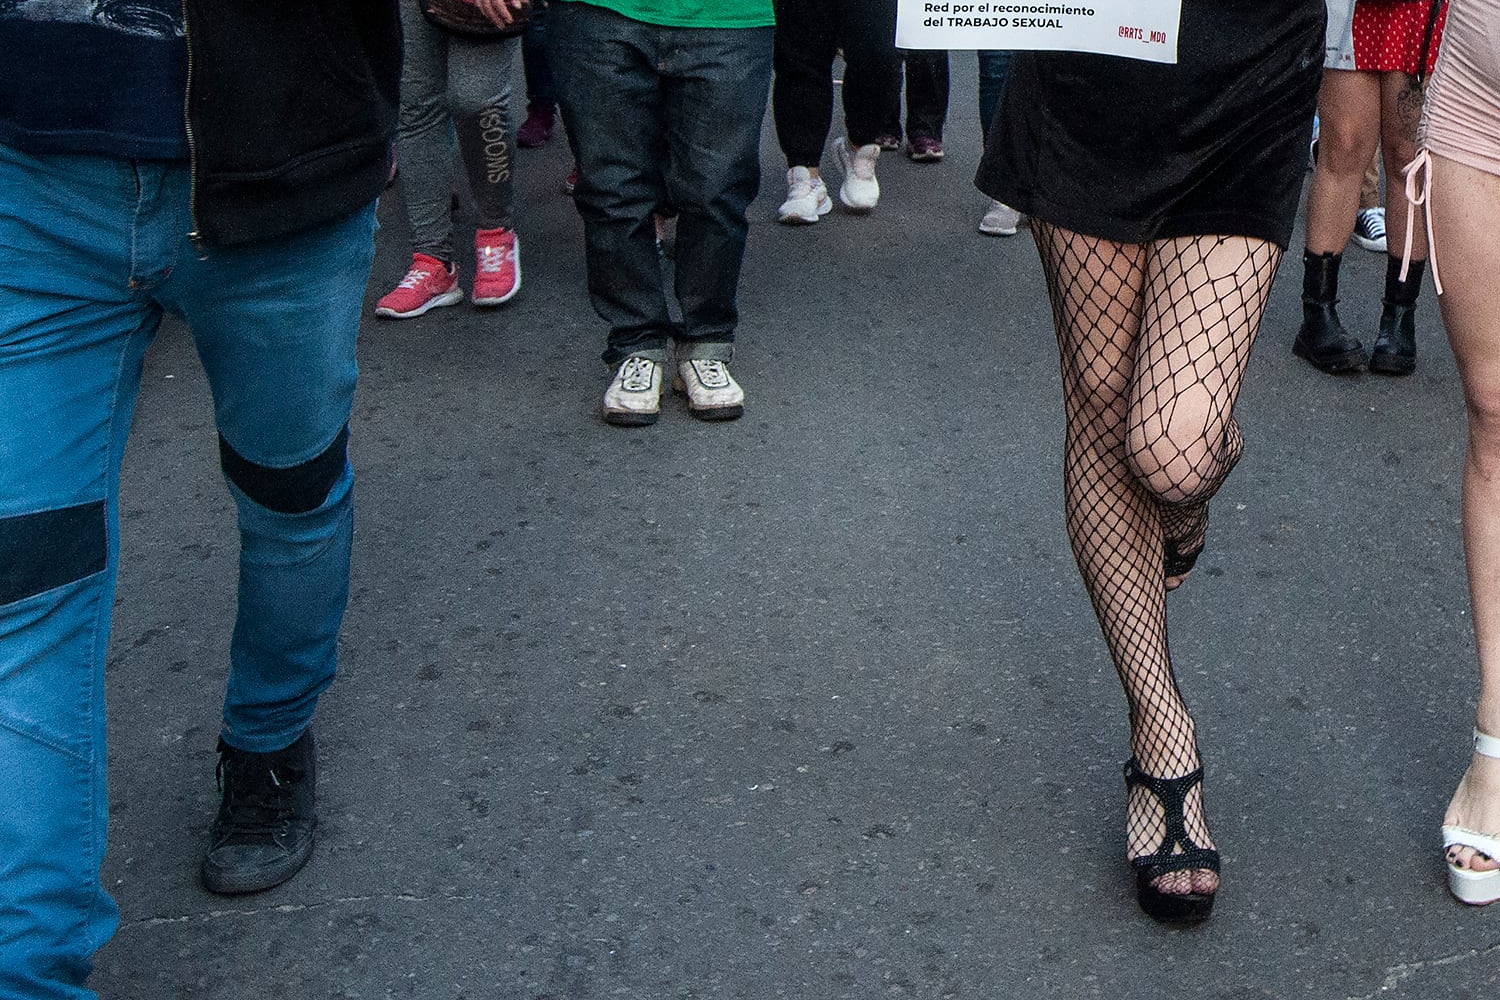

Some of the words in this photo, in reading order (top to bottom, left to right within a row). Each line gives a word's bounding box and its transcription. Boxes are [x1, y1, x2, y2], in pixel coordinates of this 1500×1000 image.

[924, 3, 949, 13] Red
[953, 4, 974, 15] por
[978, 3, 989, 13] el
[993, 3, 1095, 16] reconocimiento
[923, 17, 943, 27] del
[947, 17, 1008, 28] TRABAJO
[1012, 18, 1063, 29] SEXUAL
